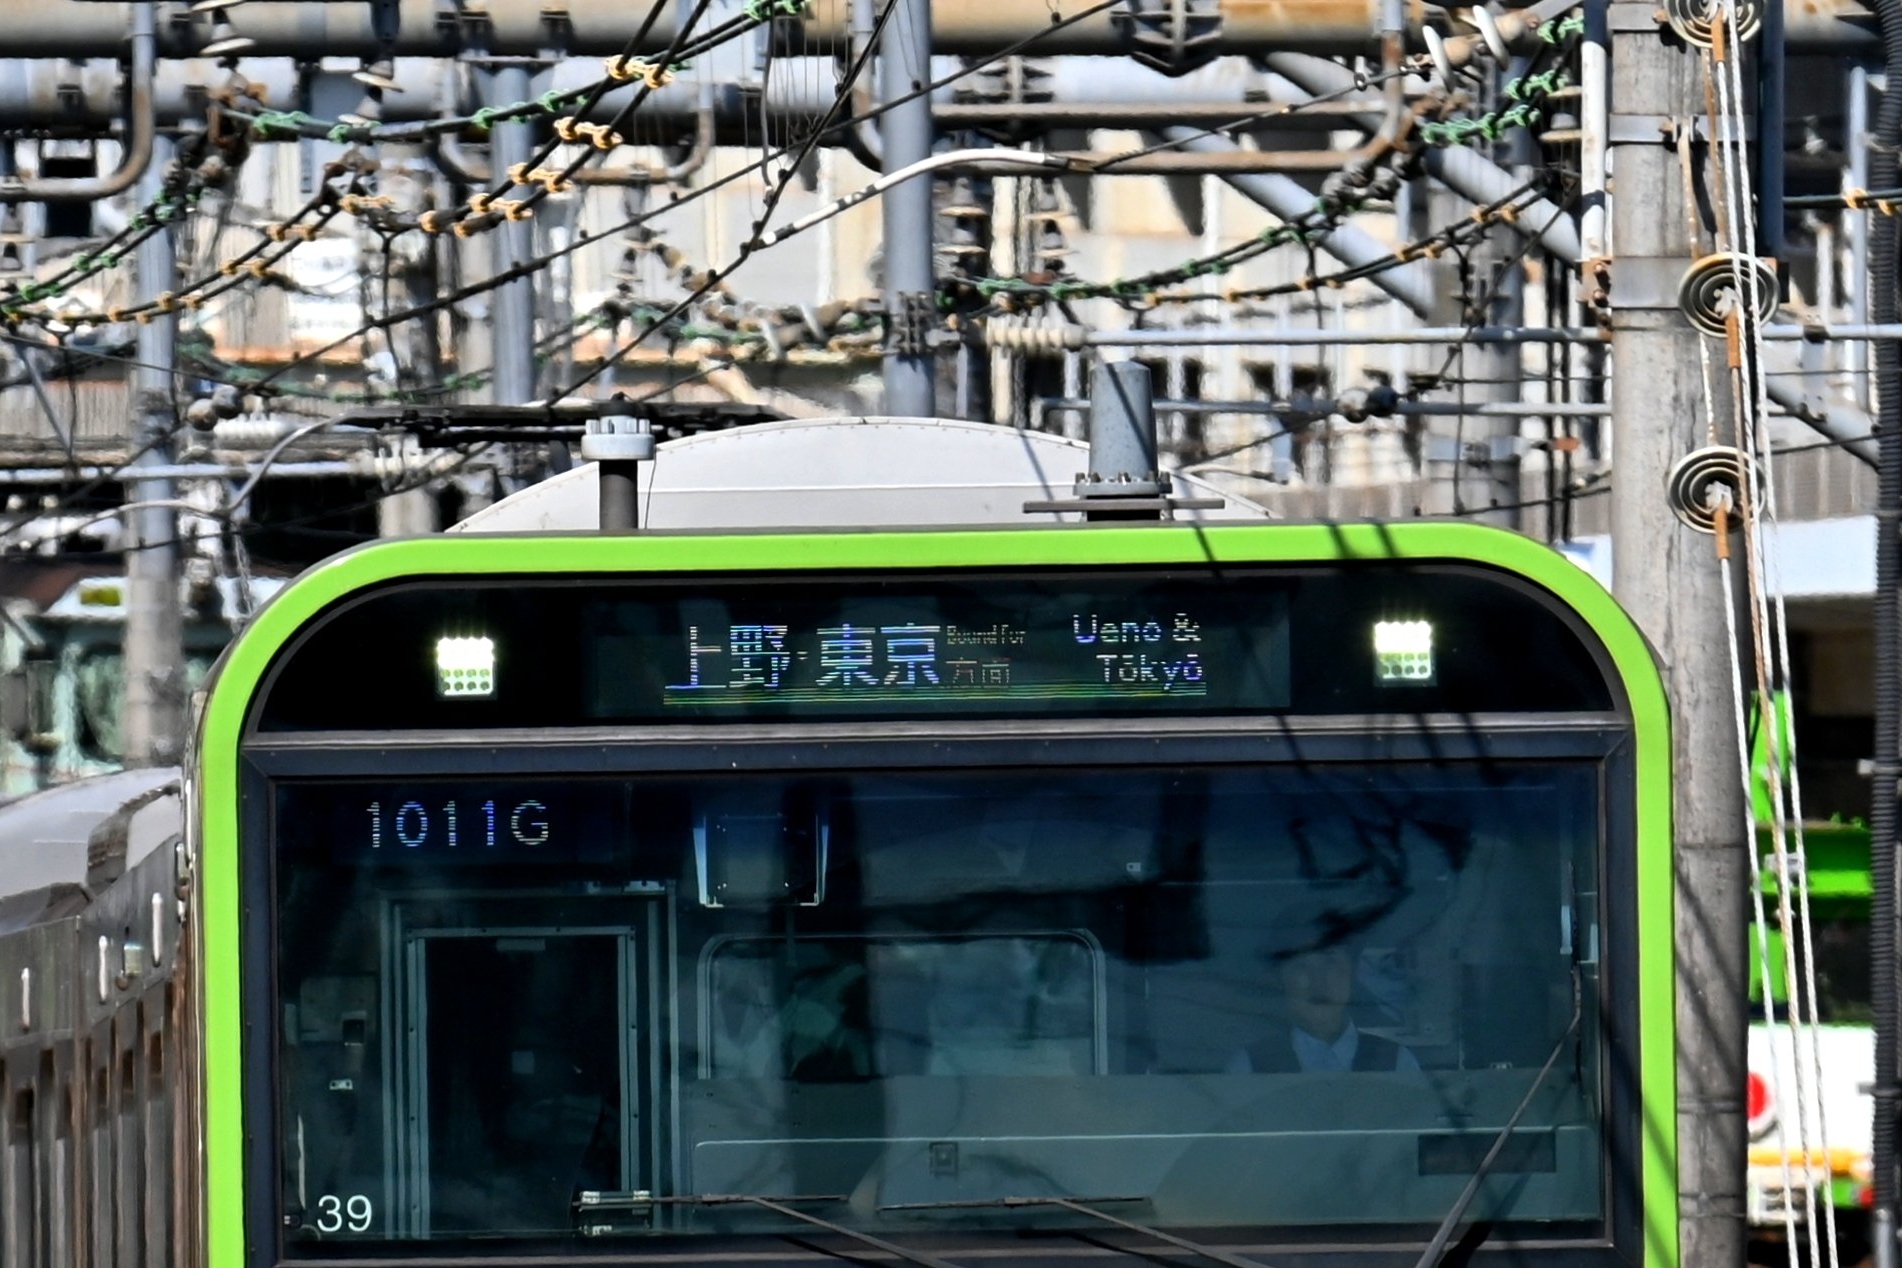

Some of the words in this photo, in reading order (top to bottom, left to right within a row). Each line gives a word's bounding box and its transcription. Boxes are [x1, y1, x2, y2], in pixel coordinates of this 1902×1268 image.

[1072, 614, 1162, 643] Ueno
[1172, 612, 1202, 642] &
[365, 800, 549, 848] 1011G
[317, 1194, 372, 1232] 39
